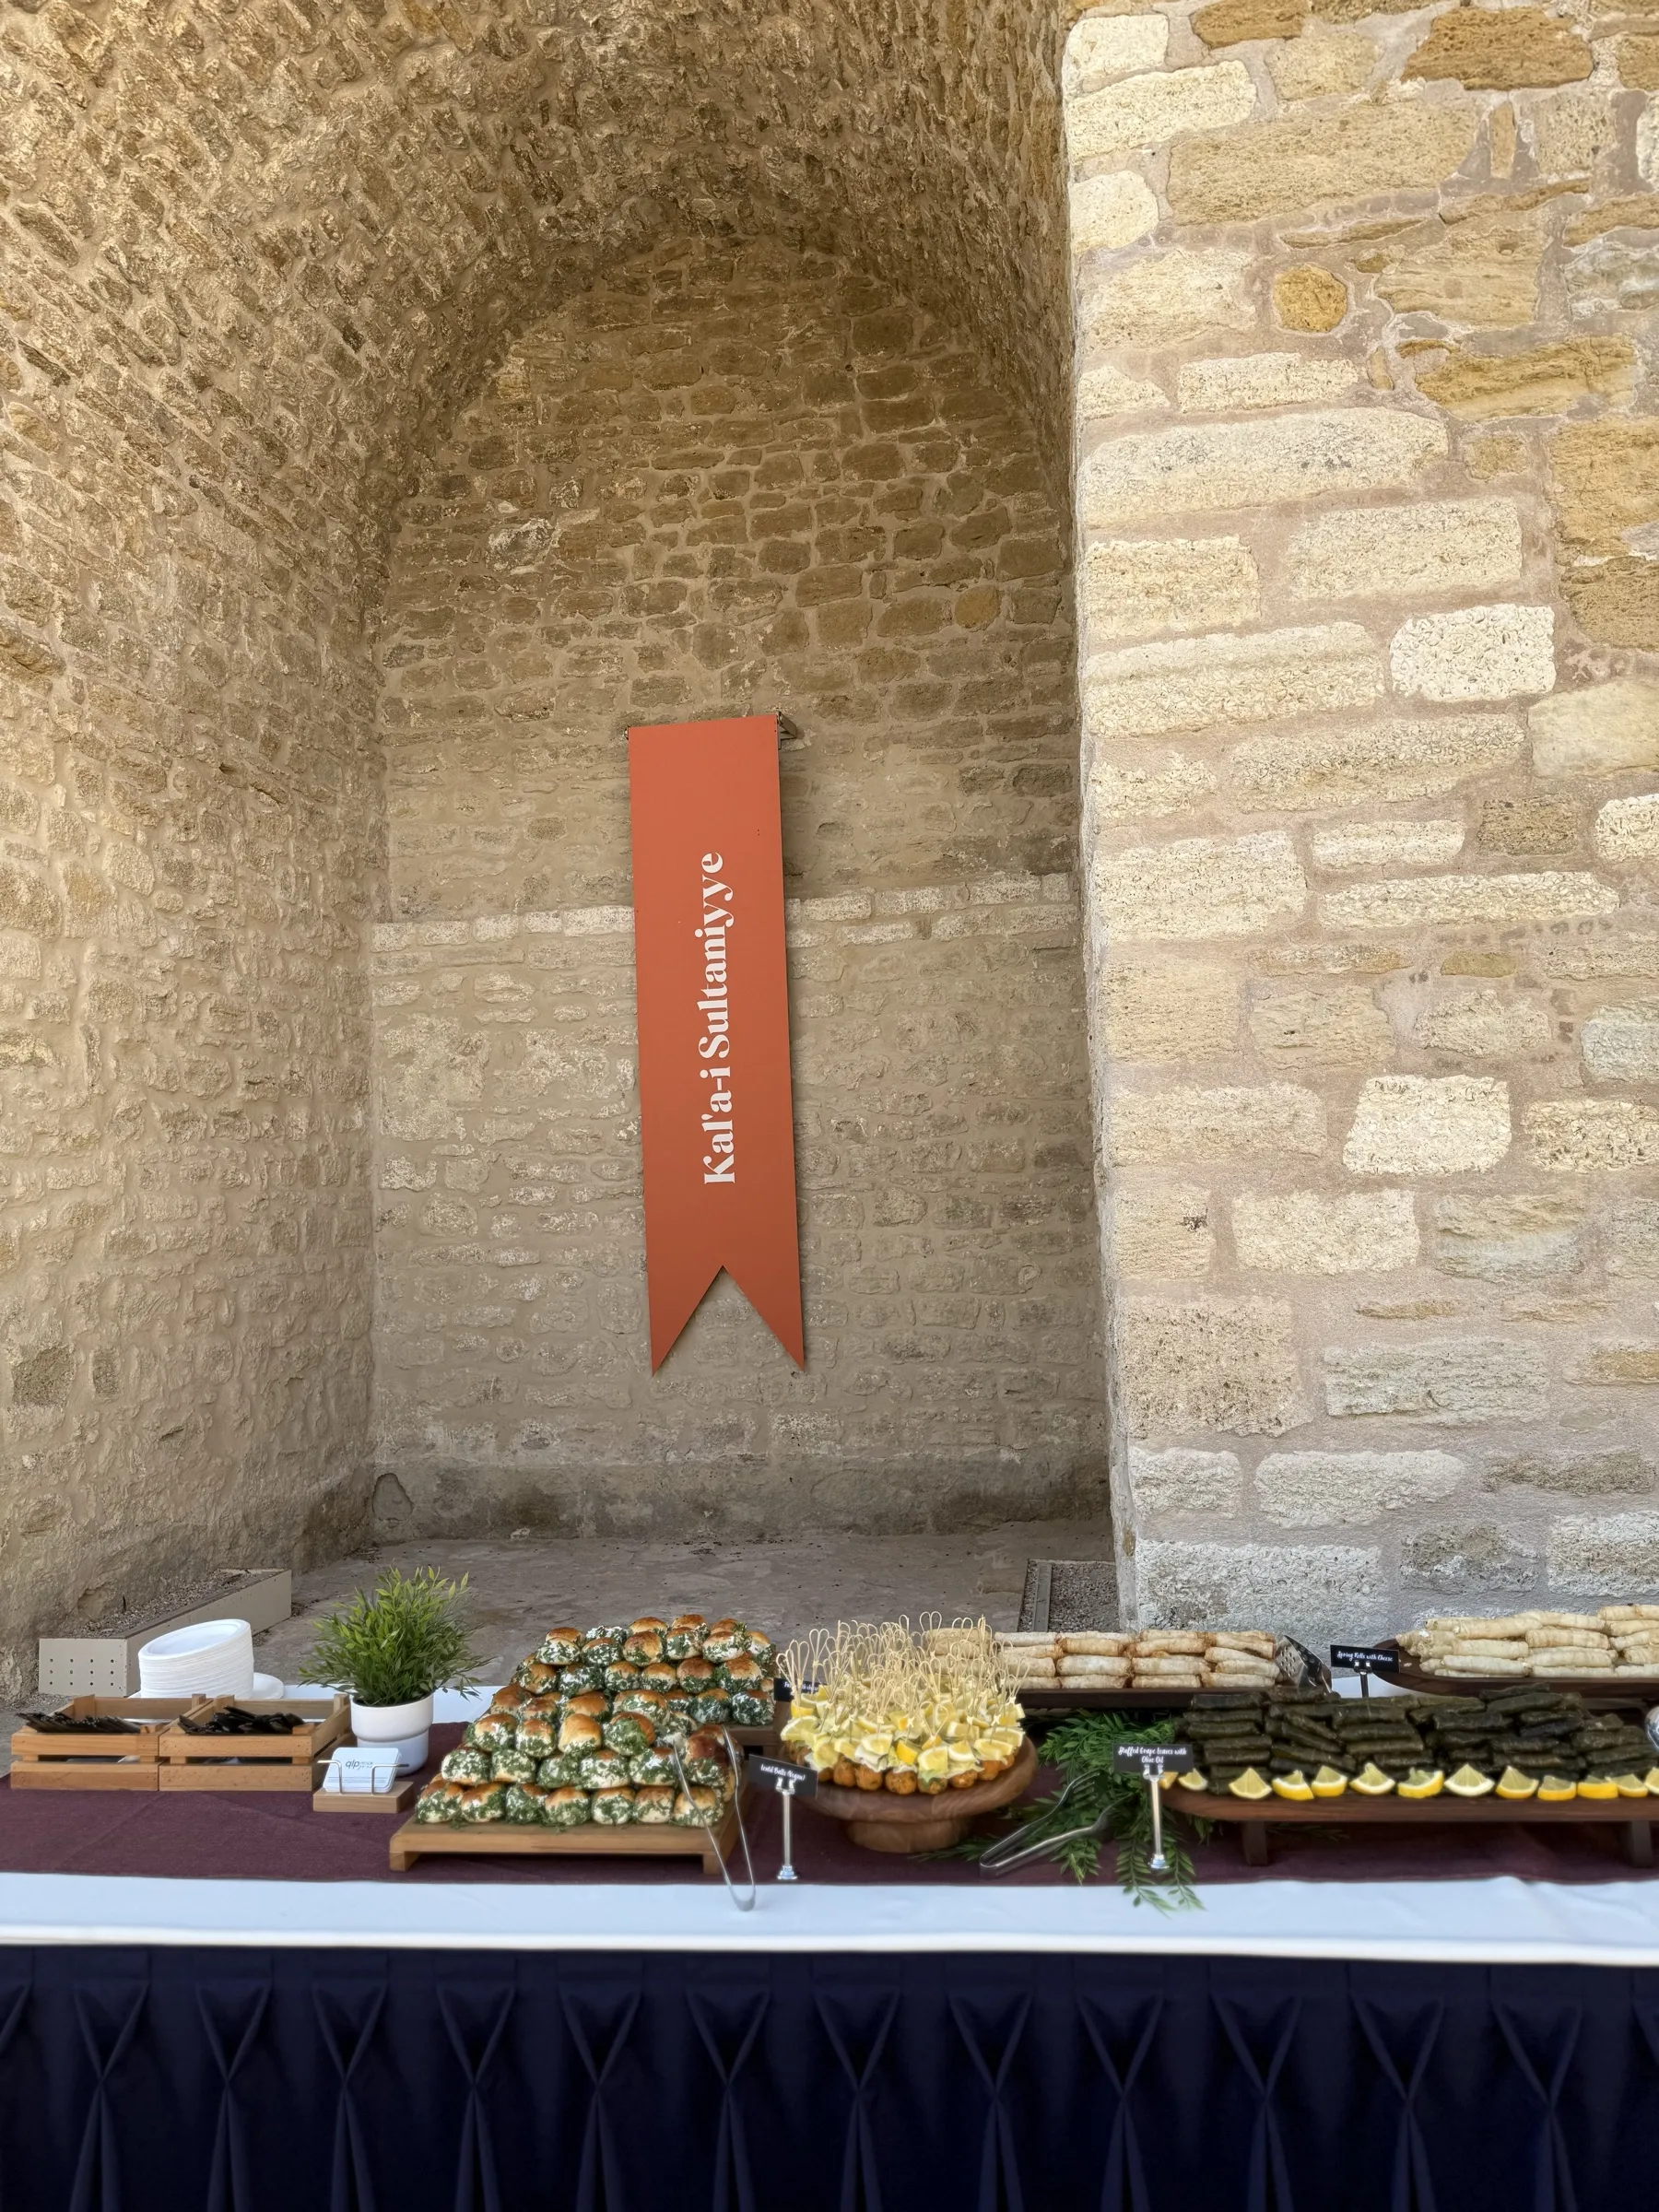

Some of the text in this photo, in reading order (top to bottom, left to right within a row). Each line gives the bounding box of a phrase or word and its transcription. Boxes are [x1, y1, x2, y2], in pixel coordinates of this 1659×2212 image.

[694, 853, 735, 1184] Kal'a-i Sultaniyye
[1336, 1651, 1353, 1662] Spring
[1118, 1746, 1139, 1757] Stuffed
[1139, 1747, 1156, 1757] Grape
[1155, 1756, 1164, 1764] Oil
